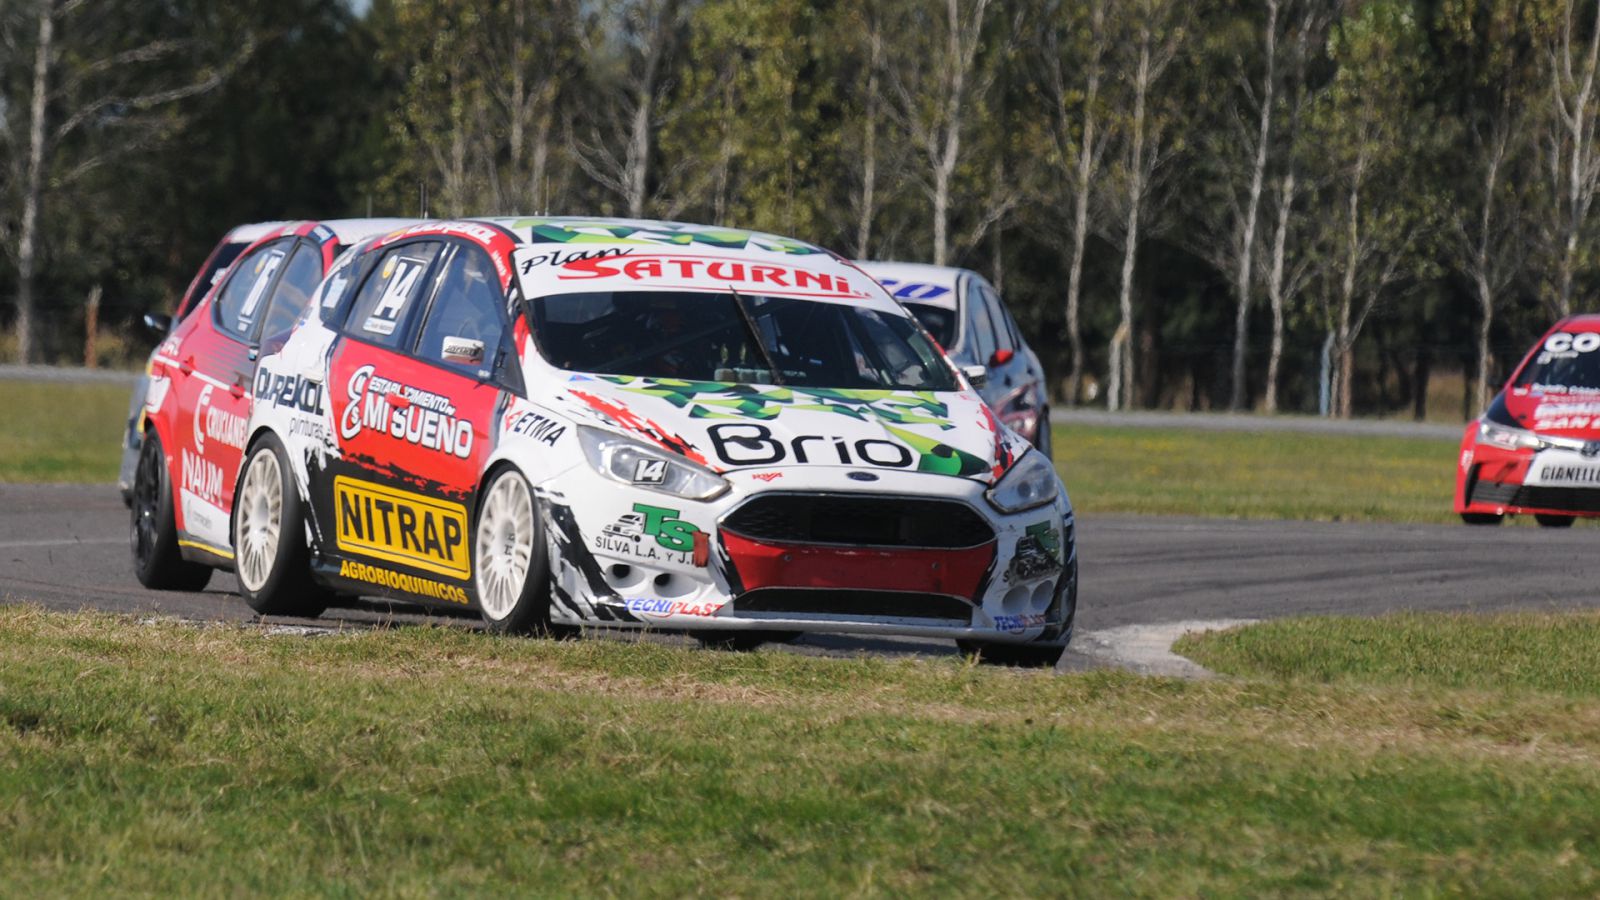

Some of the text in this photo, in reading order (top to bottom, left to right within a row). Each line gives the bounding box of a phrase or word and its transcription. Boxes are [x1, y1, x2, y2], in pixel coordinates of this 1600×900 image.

[374, 262, 422, 318] 14
[362, 391, 390, 434] MI
[513, 412, 567, 448] ETMA
[706, 423, 913, 468] Brio
[179, 447, 225, 508] NAUM
[634, 459, 665, 482] 14
[340, 490, 462, 562] NITRAP
[595, 536, 631, 555] SILVA
[634, 544, 661, 560] L.A.
[339, 559, 469, 605] AGROBIOQUIMICOS
[623, 598, 725, 618] TECNIPLAST
